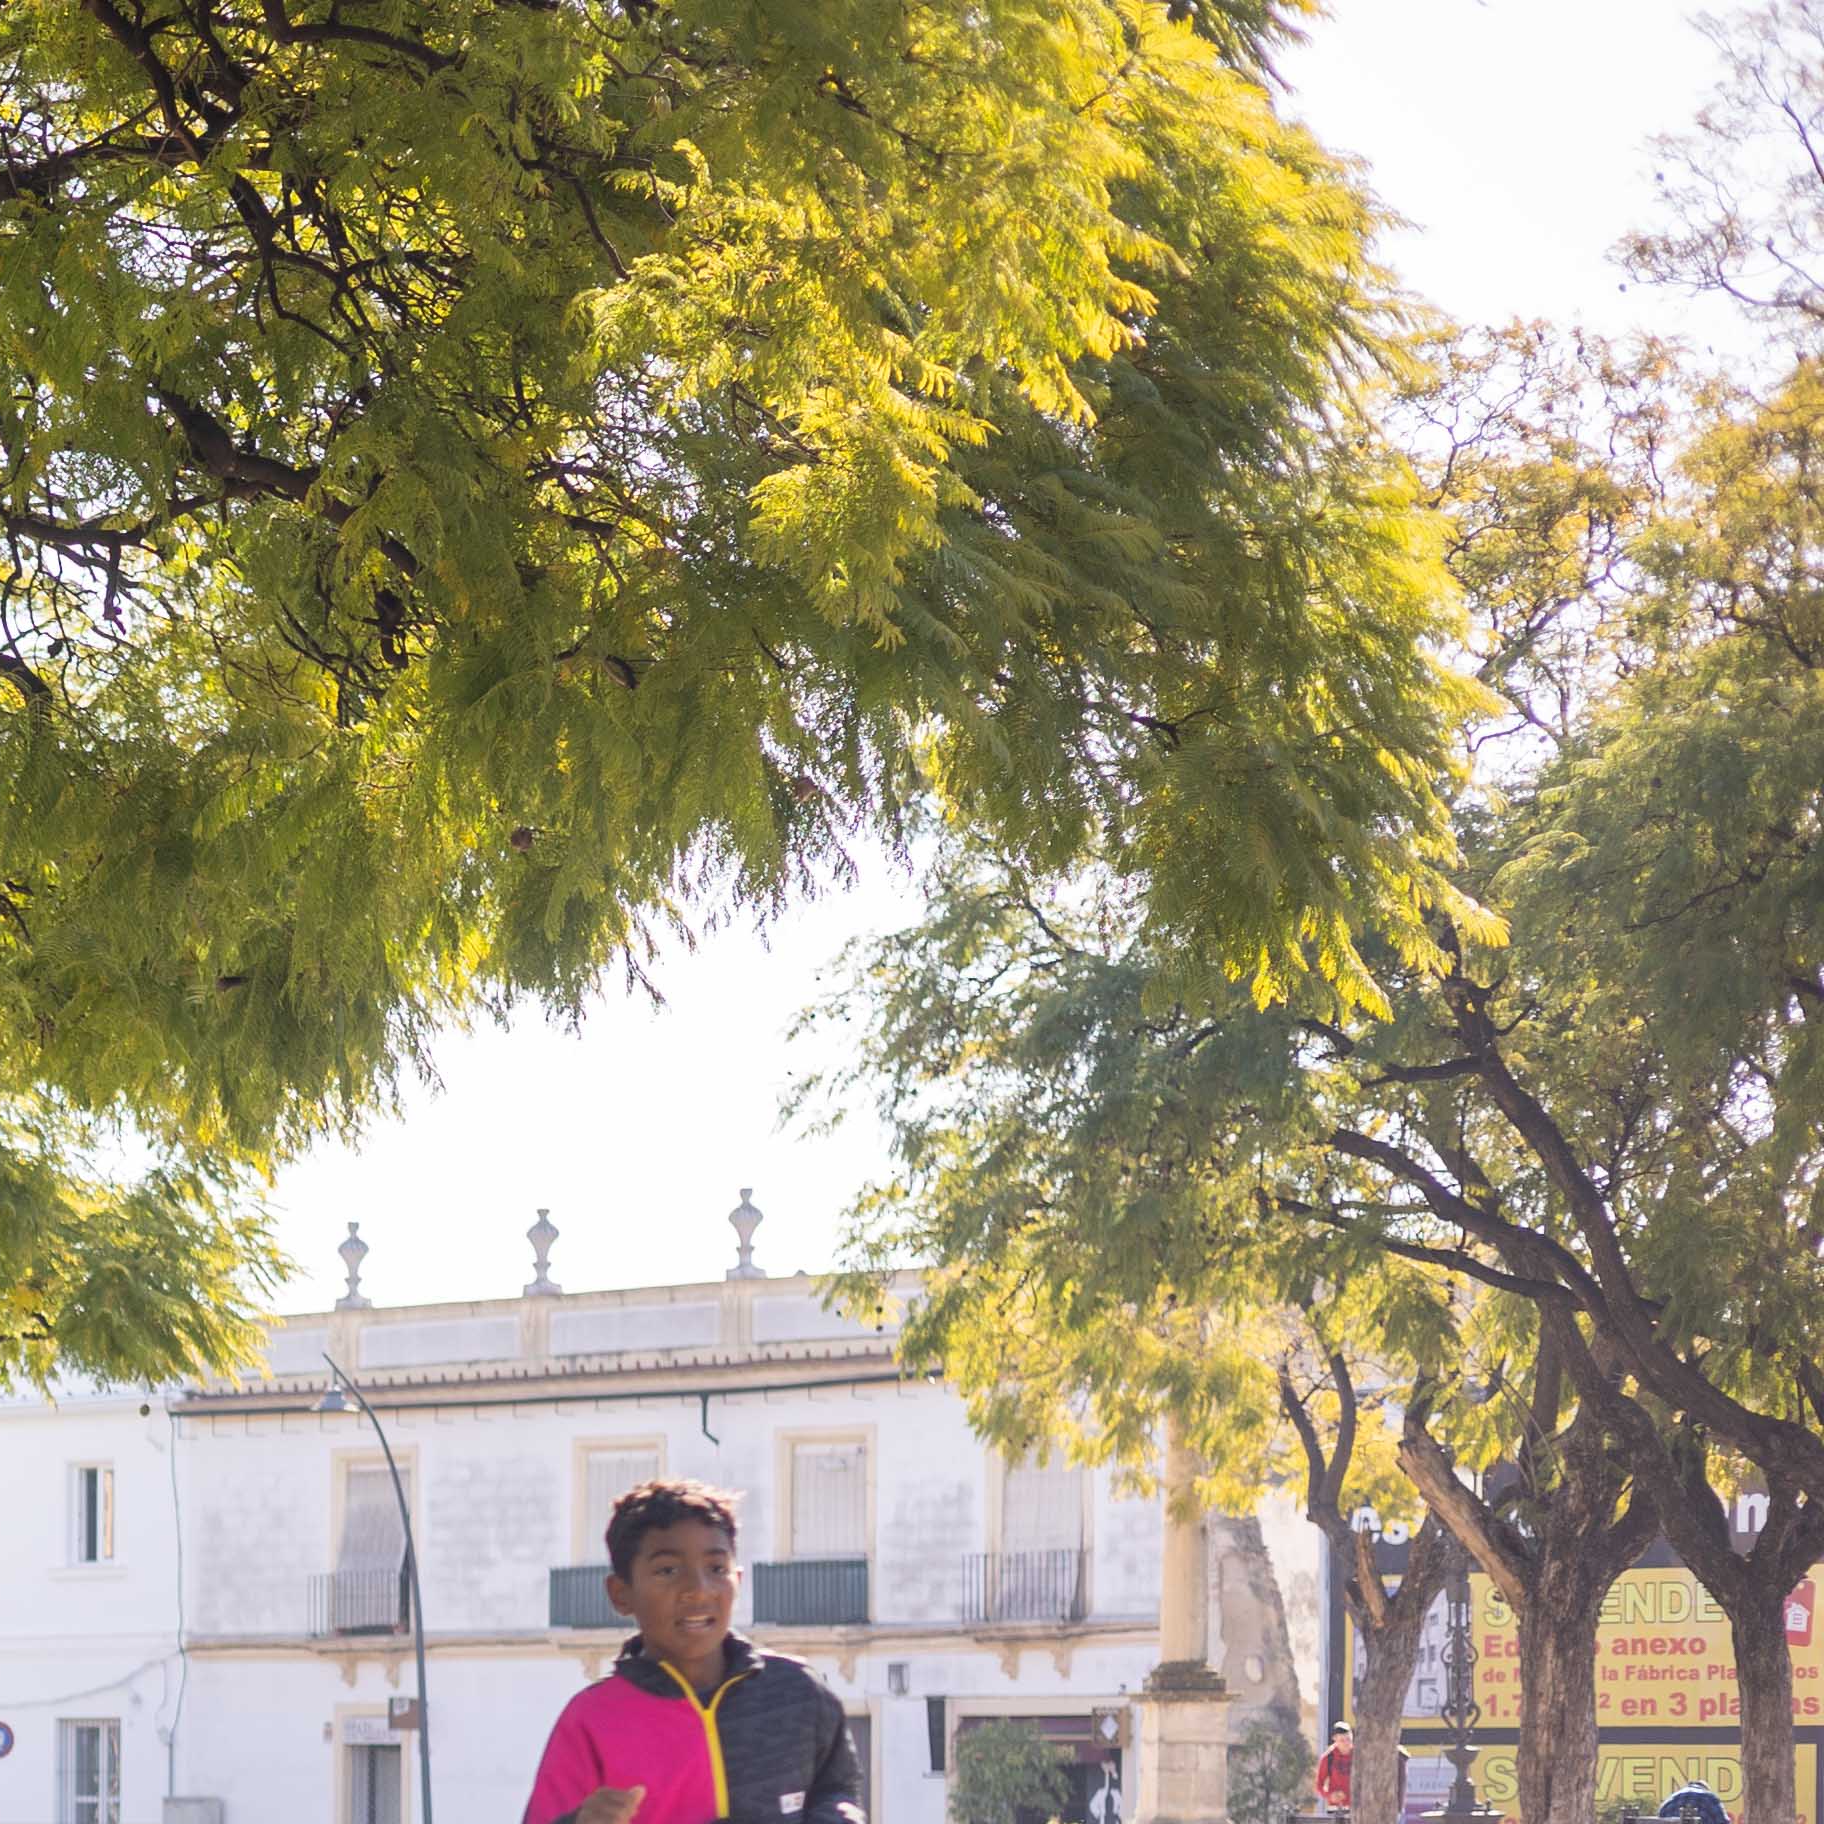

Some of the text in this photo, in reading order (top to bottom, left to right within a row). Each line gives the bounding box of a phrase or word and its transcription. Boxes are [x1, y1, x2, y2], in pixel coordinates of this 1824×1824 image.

[1598, 1581, 1725, 1624] ENDE
[1612, 1636, 1707, 1656] anexo
[1482, 1666, 1506, 1683] de
[1625, 1664, 1700, 1681] Fábrica
[1621, 1697, 1657, 1716] en
[1669, 1692, 1687, 1716] 3
